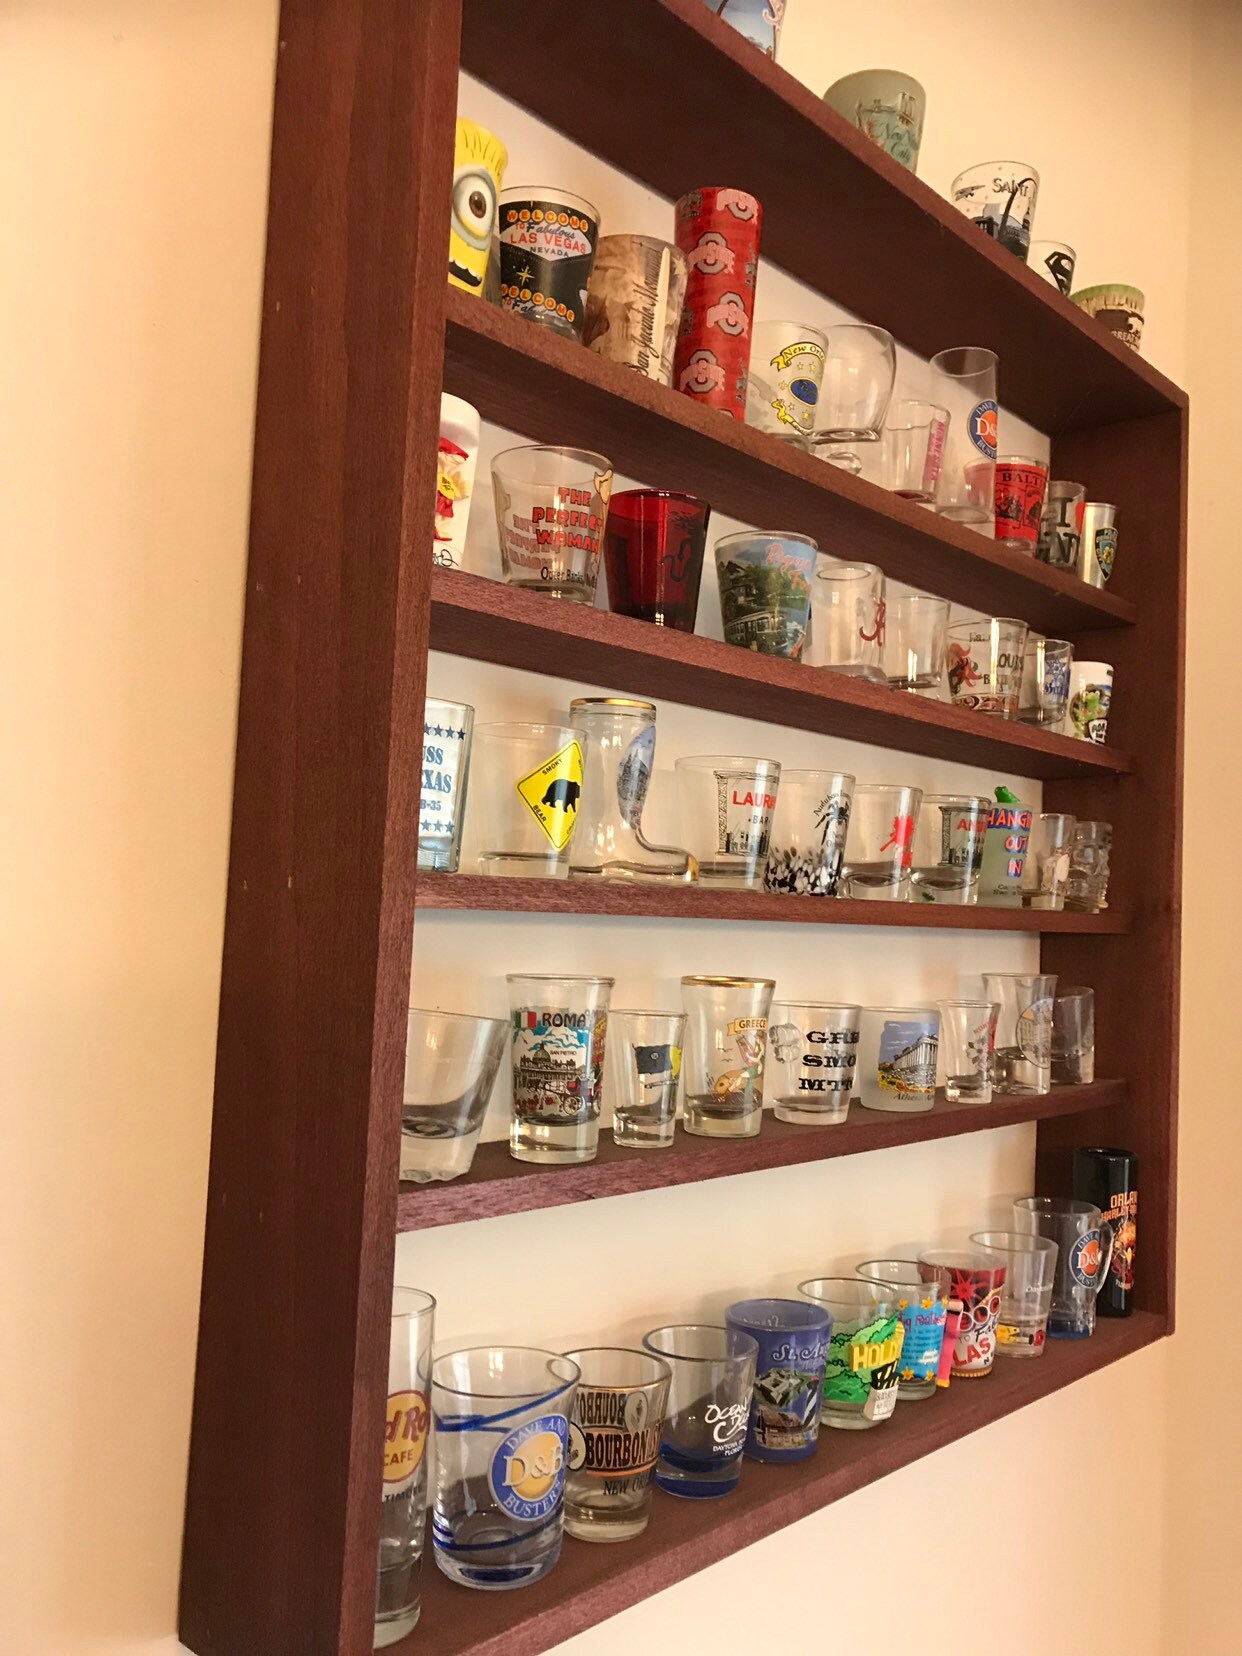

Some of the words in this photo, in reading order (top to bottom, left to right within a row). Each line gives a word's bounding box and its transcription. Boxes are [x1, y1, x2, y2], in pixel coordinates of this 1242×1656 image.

[506, 209, 589, 233] WELCOME
[515, 222, 525, 231] TO
[526, 221, 576, 240] Fabulous
[510, 233, 538, 245] LAS
[544, 233, 587, 256] VEGAS
[530, 246, 569, 258] NEVADA
[783, 345, 807, 360] New
[558, 486, 592, 507] THE
[536, 528, 600, 554] WOMAN
[542, 758, 563, 775] SMOKY
[532, 803, 548, 823] BEAR
[1005, 834, 1028, 854] OUT
[1007, 857, 1023, 878] IN
[542, 1012, 587, 1028] ROMA
[738, 1019, 767, 1030] GREECE
[952, 1337, 991, 1367] LAS
[507, 1421, 543, 1451] DAVE
[546, 1418, 566, 1437] AND
[585, 1429, 649, 1468] BOURBON
[502, 1446, 564, 1487] D&B
[603, 1479, 628, 1496] NEW
